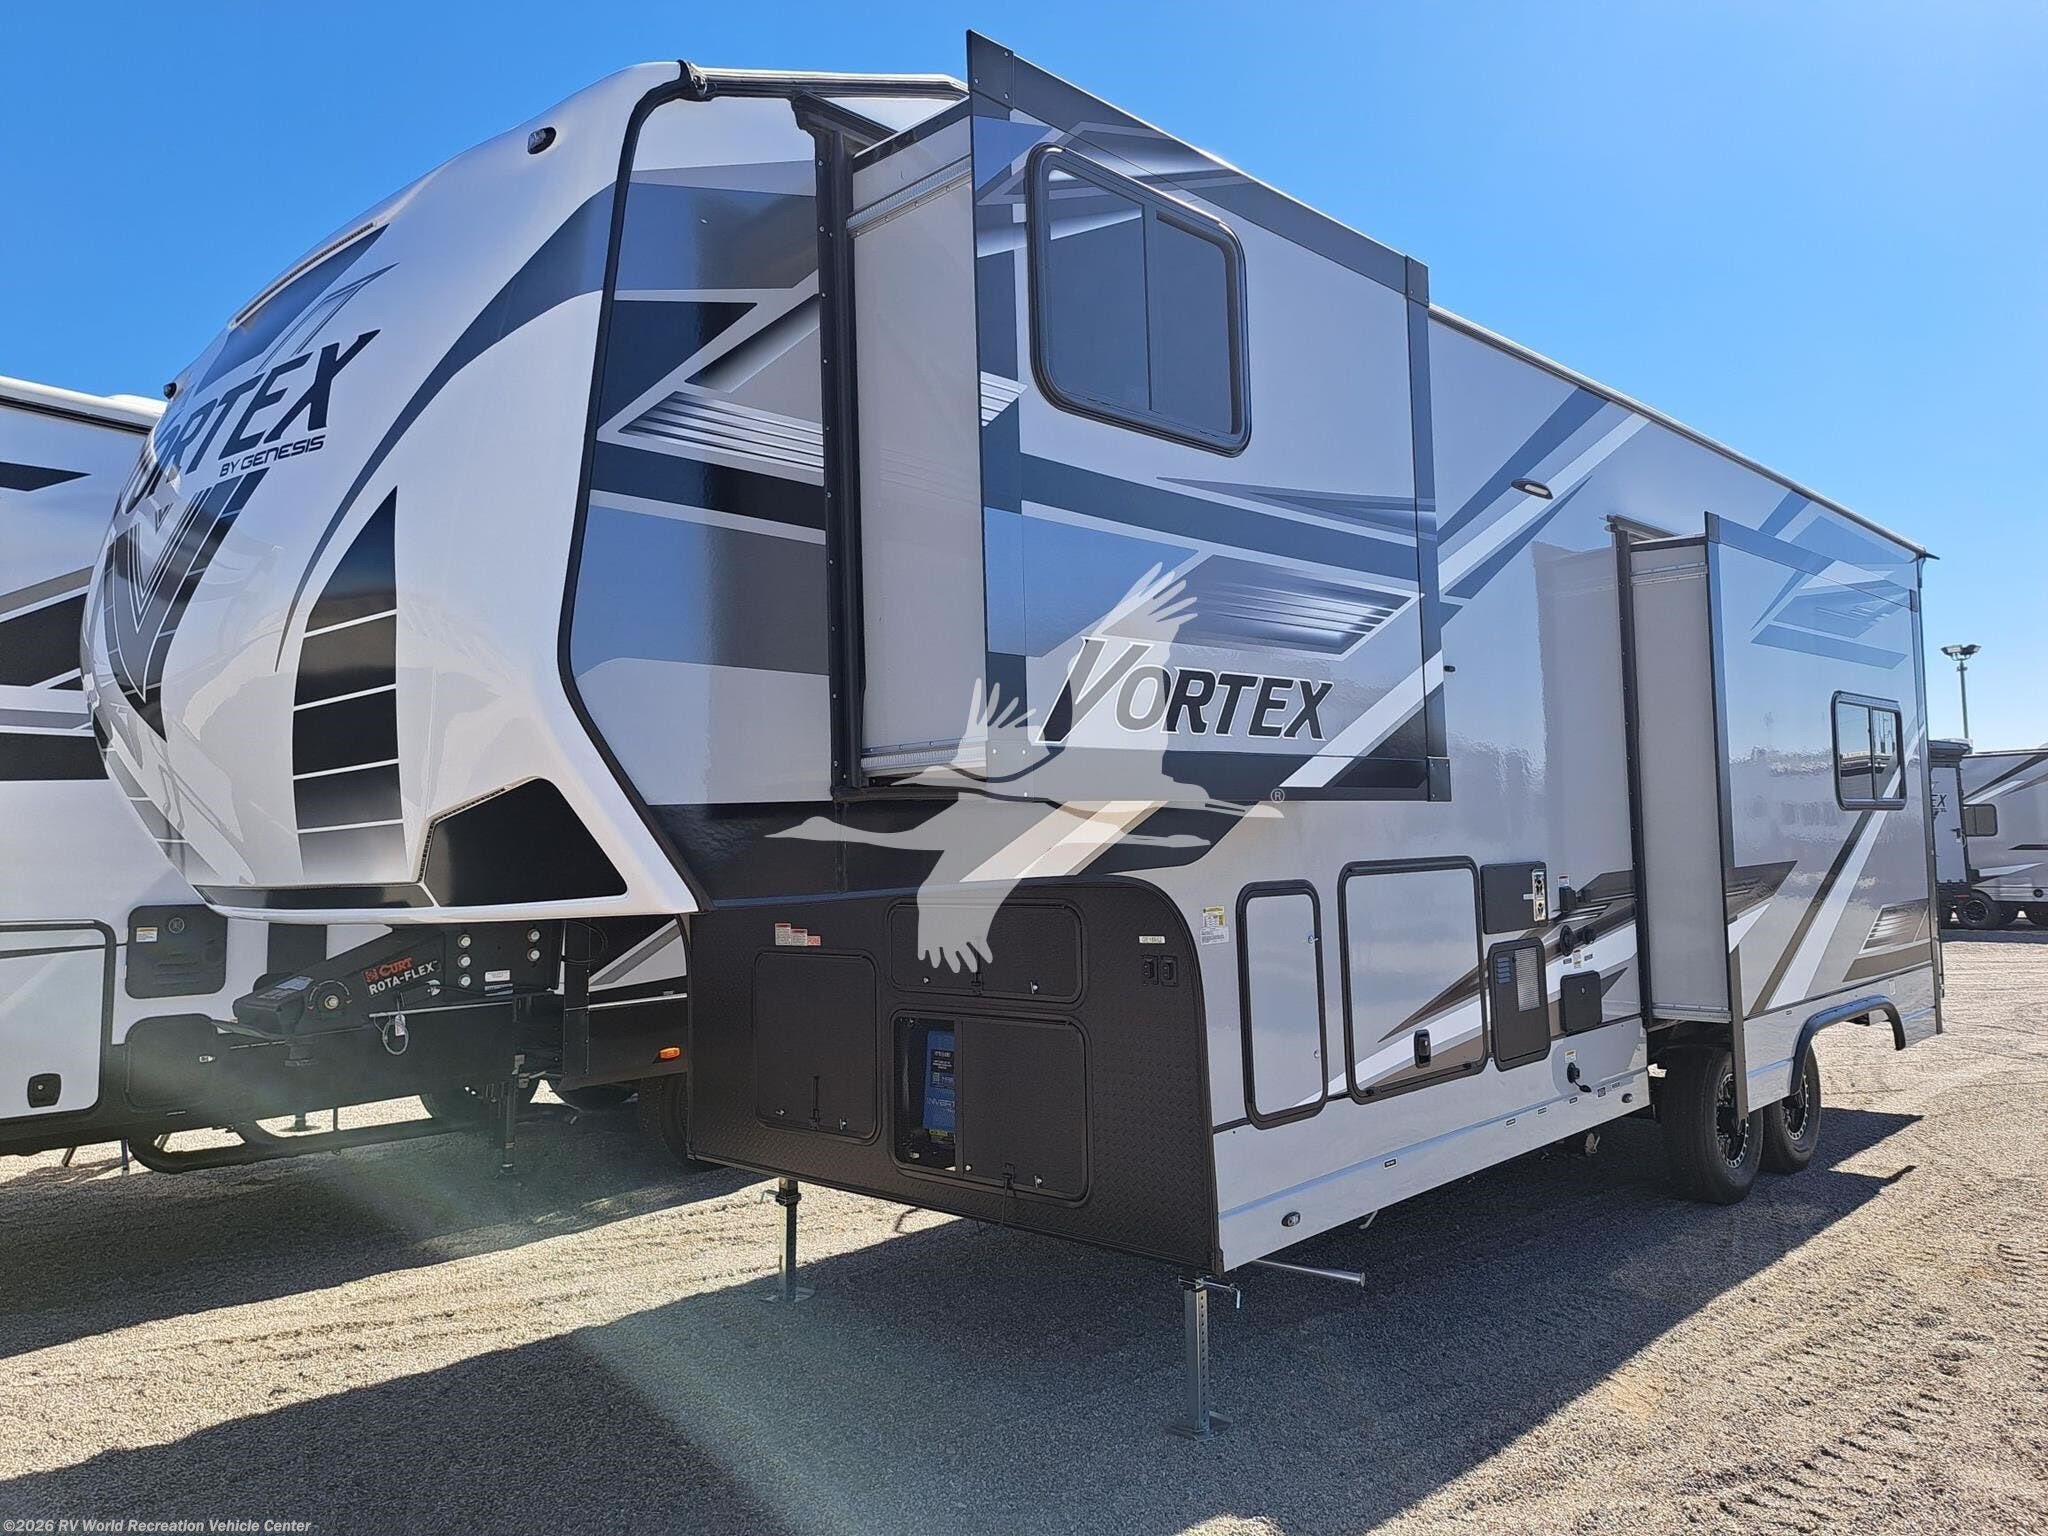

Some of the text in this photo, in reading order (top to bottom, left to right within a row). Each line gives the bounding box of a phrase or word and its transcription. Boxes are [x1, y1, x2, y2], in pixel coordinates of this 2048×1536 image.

[219, 434, 326, 478] BY GENESIS
[1036, 636, 1335, 744] VORTEX
[379, 957, 414, 977] CURT
